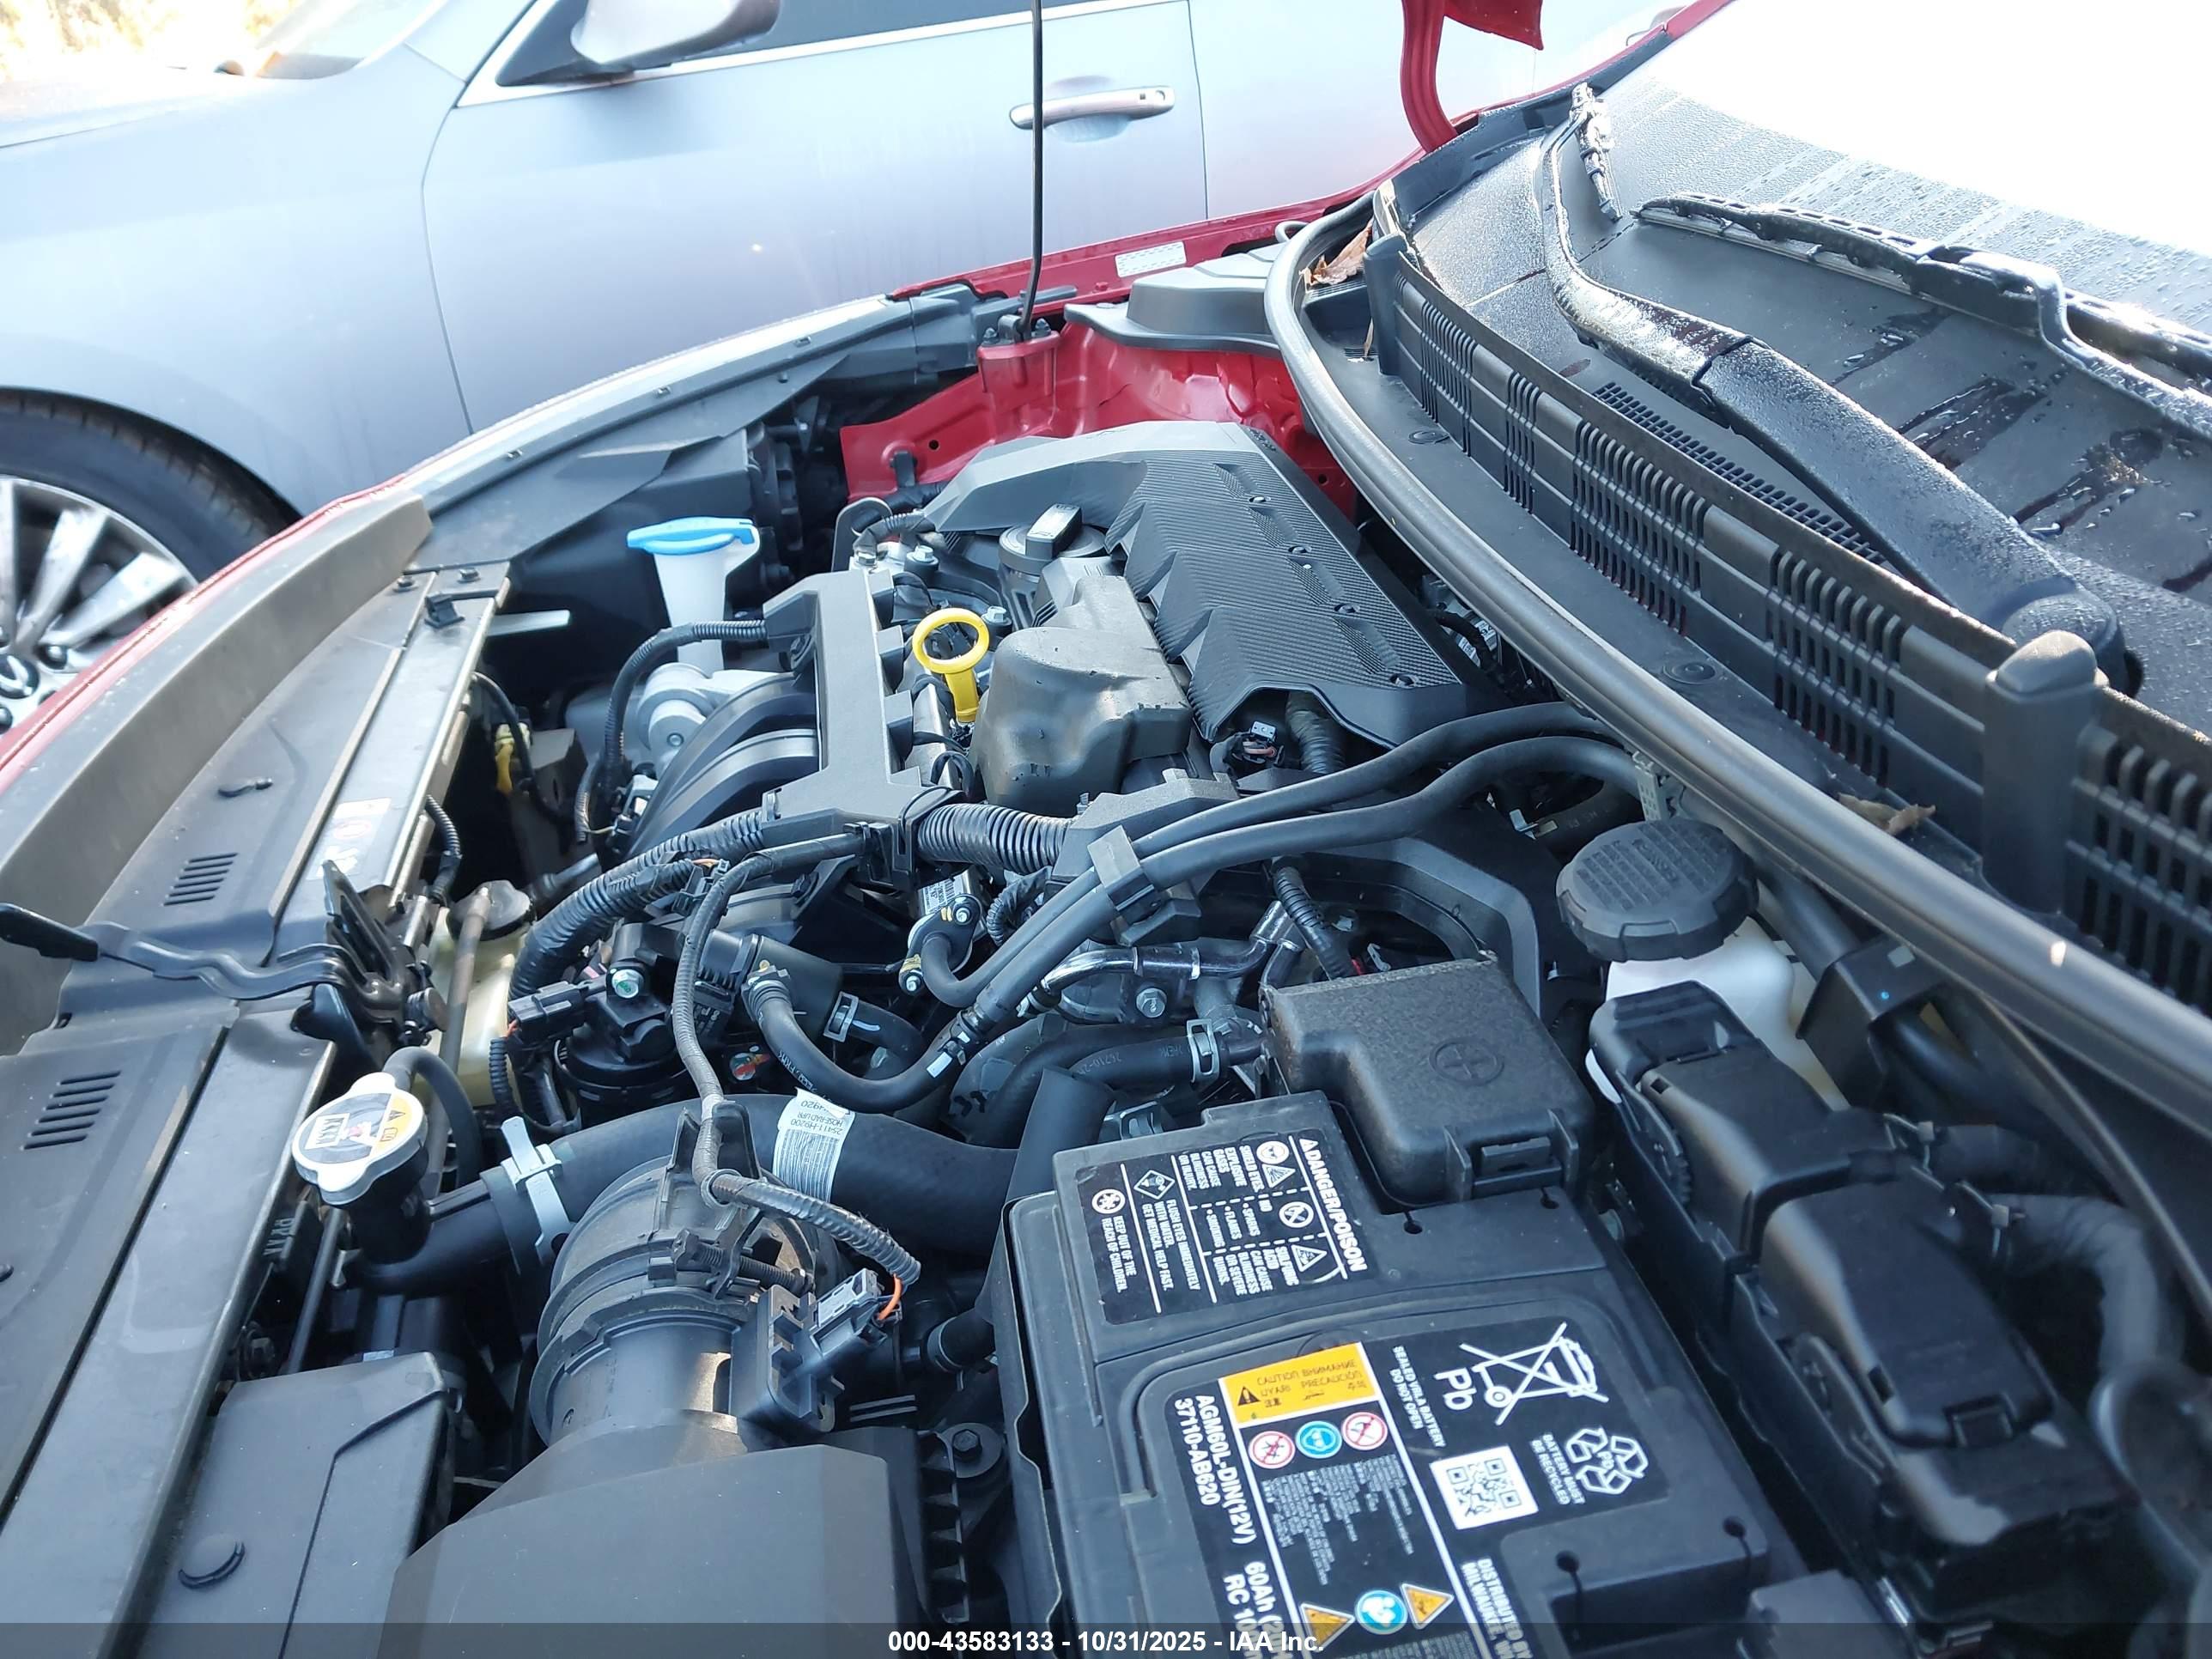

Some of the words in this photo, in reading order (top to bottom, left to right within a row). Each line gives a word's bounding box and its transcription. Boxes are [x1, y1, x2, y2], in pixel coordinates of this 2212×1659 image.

[1304, 1150, 1367, 1271] DANGER/POISON
[1257, 1370, 1299, 1386] CAUTION
[1389, 1368, 1404, 1383] DO
[1392, 1345, 1416, 1382] SEALED
[1419, 1405, 1446, 1448] BATTERY
[1396, 1382, 1413, 1402] NOT
[1433, 1367, 1477, 1411] Pb
[1404, 1402, 1424, 1430] OPEN
[1175, 1397, 1221, 1506] 37110-AB620
[1196, 1395, 1257, 1545] AGM60L-DIN(12V)
[1531, 1439, 1546, 1453] BE
[1539, 1453, 1571, 1505] RECYCLED
[1542, 1433, 1571, 1475] BATTERY
[1564, 1476, 1585, 1504] MUST
[1223, 1573, 1250, 1605] RC
[1244, 1561, 1276, 1613] 60Ah
[1478, 1559, 1523, 1640] DISTRIBUTED
